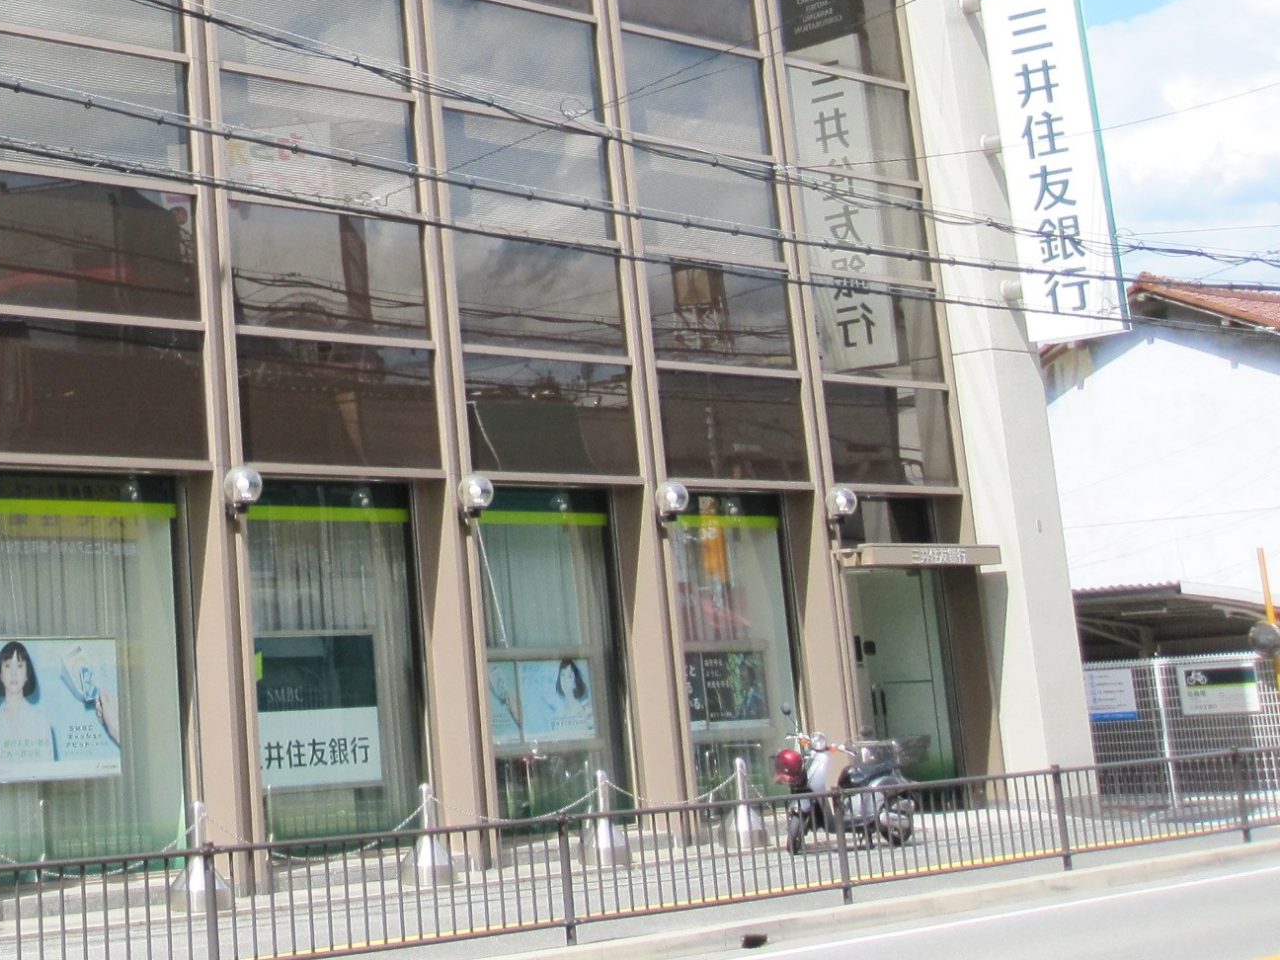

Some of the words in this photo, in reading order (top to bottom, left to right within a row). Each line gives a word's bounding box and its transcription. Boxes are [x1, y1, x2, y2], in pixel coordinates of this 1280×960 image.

[1007, 7, 1091, 317] 三井住友銀行
[261, 736, 371, 771] 井住友銀行
